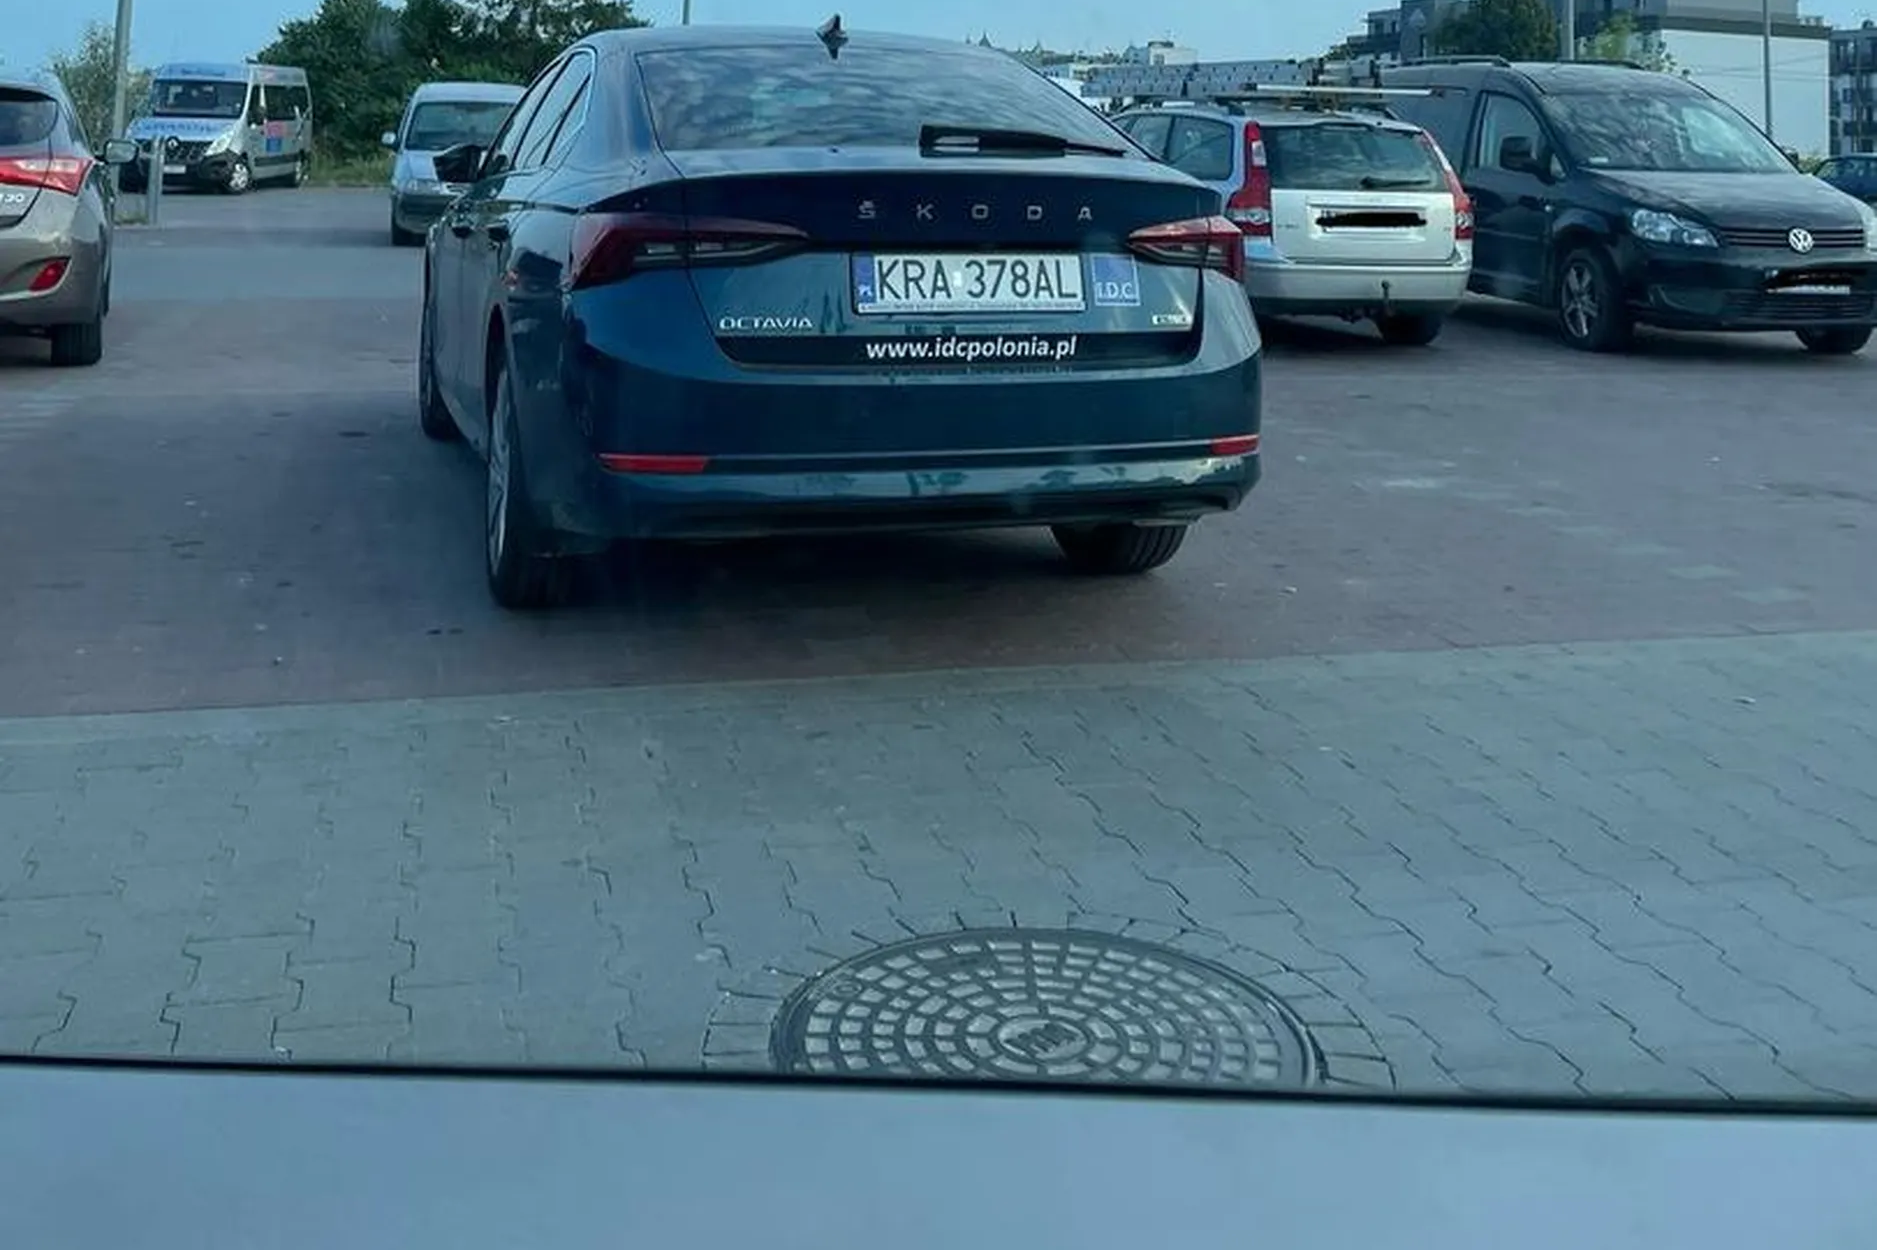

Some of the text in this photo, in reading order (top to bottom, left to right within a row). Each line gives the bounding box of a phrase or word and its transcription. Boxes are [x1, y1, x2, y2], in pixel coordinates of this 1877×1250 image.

[857, 200, 1093, 221] ŠKODA
[877, 259, 1078, 300] KRA 378AL
[719, 316, 813, 331] OCTAVIA
[866, 335, 1077, 361] www.idcpolonia.pl
